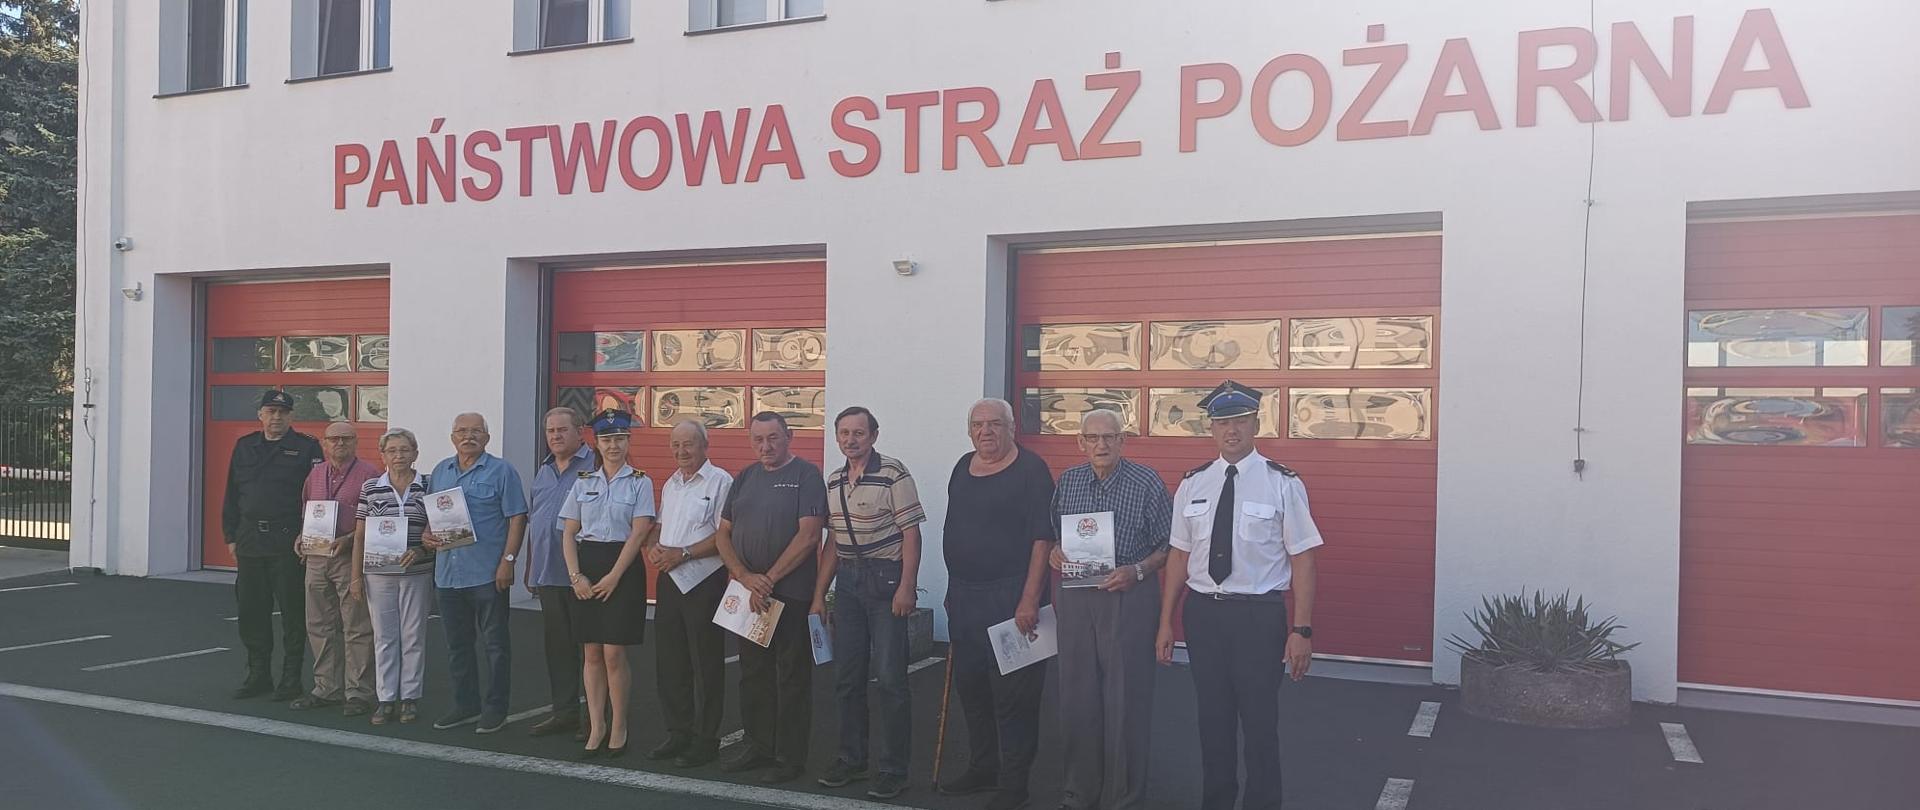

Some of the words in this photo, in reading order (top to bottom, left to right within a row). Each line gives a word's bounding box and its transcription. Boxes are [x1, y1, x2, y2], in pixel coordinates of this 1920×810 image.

[334, 104, 804, 210] PAŃSTWOWA
[829, 52, 1141, 178] STRAŻ
[1180, 9, 1810, 153] POŻARNA
